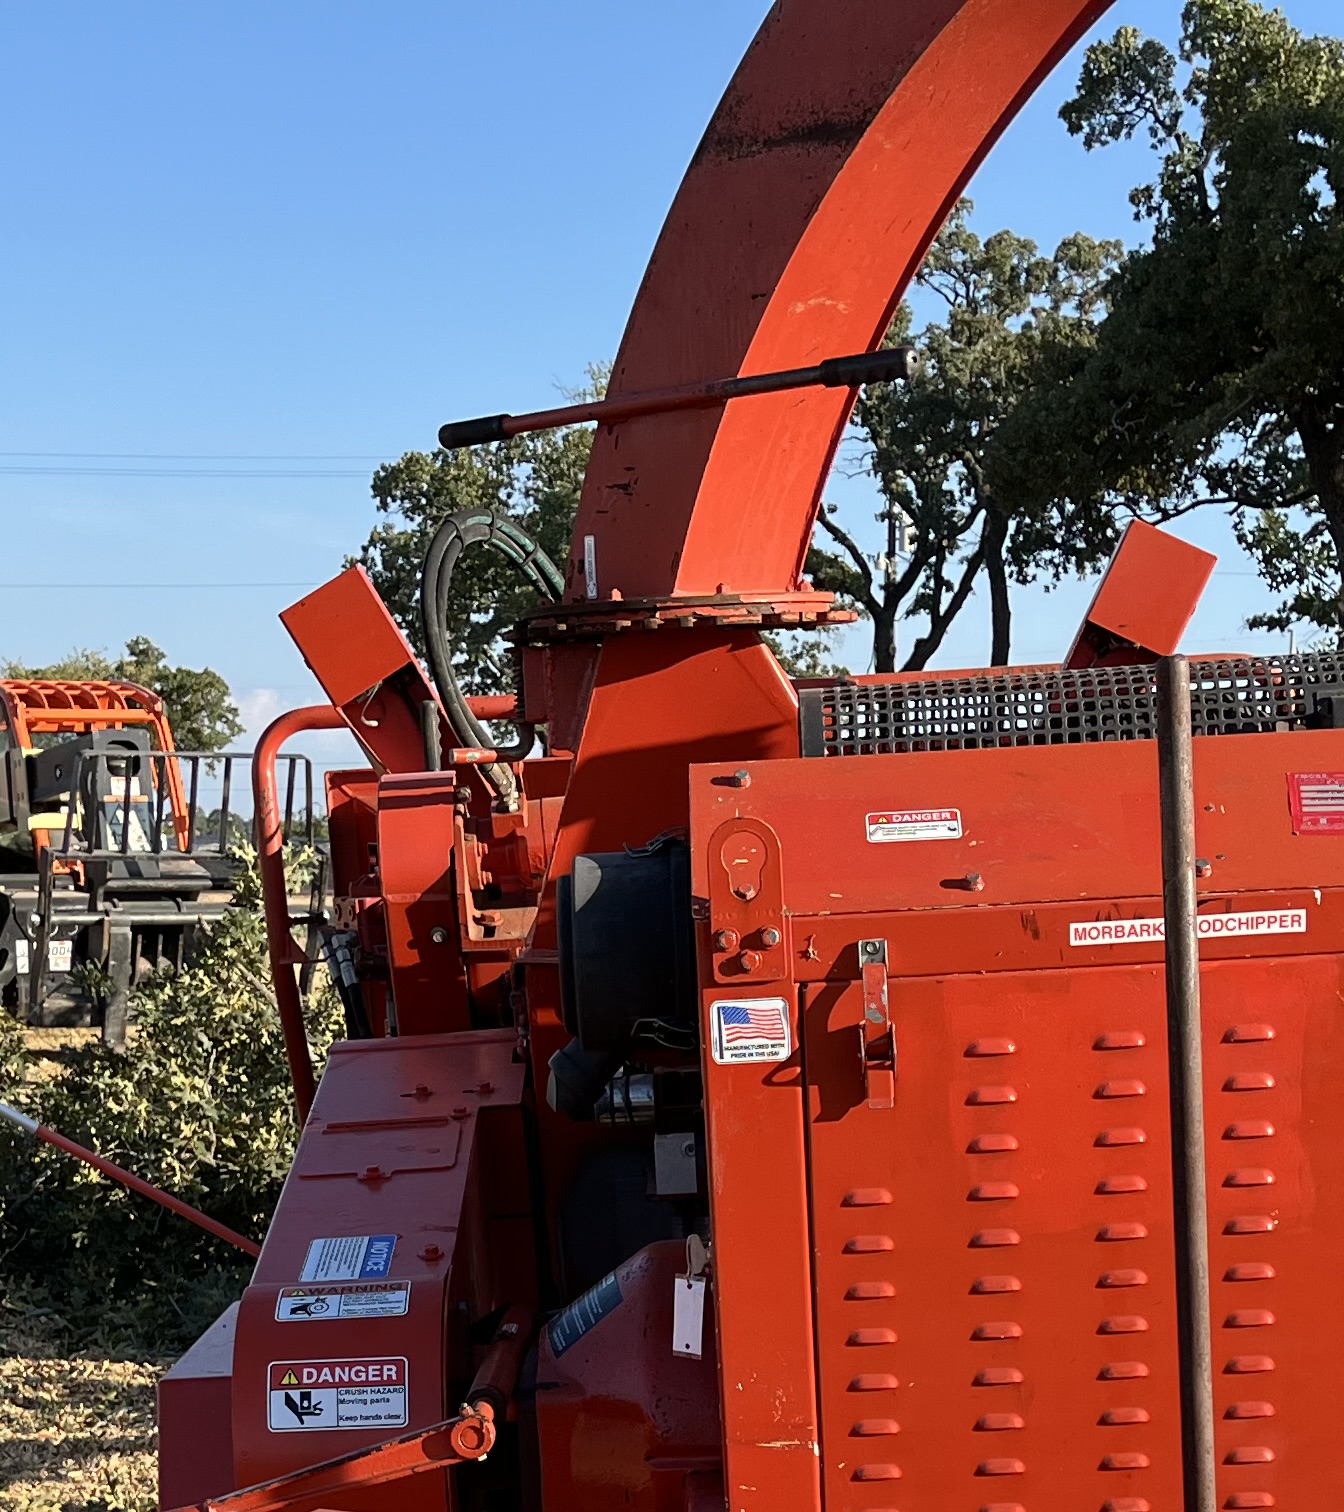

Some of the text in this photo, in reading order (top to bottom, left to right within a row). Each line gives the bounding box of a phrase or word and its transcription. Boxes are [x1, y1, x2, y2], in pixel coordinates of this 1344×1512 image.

[892, 812, 951, 823] DANGER
[1074, 914, 1302, 941] MORBARK ODCHIPPER
[366, 1241, 391, 1272] NOTICE
[308, 1283, 403, 1295] WARNING
[302, 1364, 398, 1384] DANGER
[338, 1387, 405, 1397] CRUSH HAZARD
